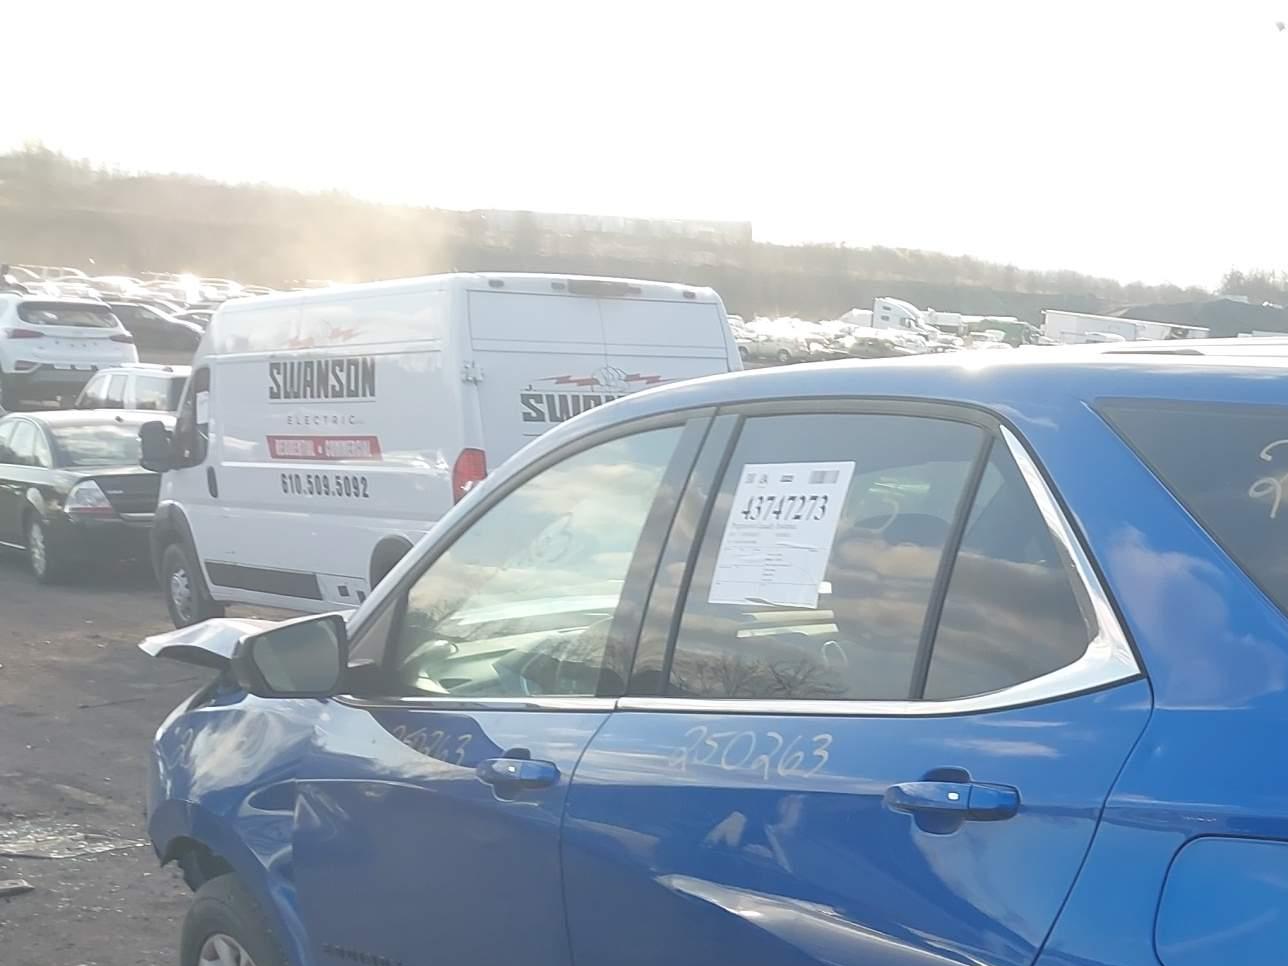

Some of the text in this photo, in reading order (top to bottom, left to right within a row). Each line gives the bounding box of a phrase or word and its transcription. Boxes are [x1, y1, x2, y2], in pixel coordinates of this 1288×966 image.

[269, 358, 376, 400] SWANSON
[287, 415, 357, 425] ELECTRIC
[280, 473, 370, 498] 610.509.5092
[741, 495, 829, 520] 43747273
[668, 725, 833, 780] 250263
